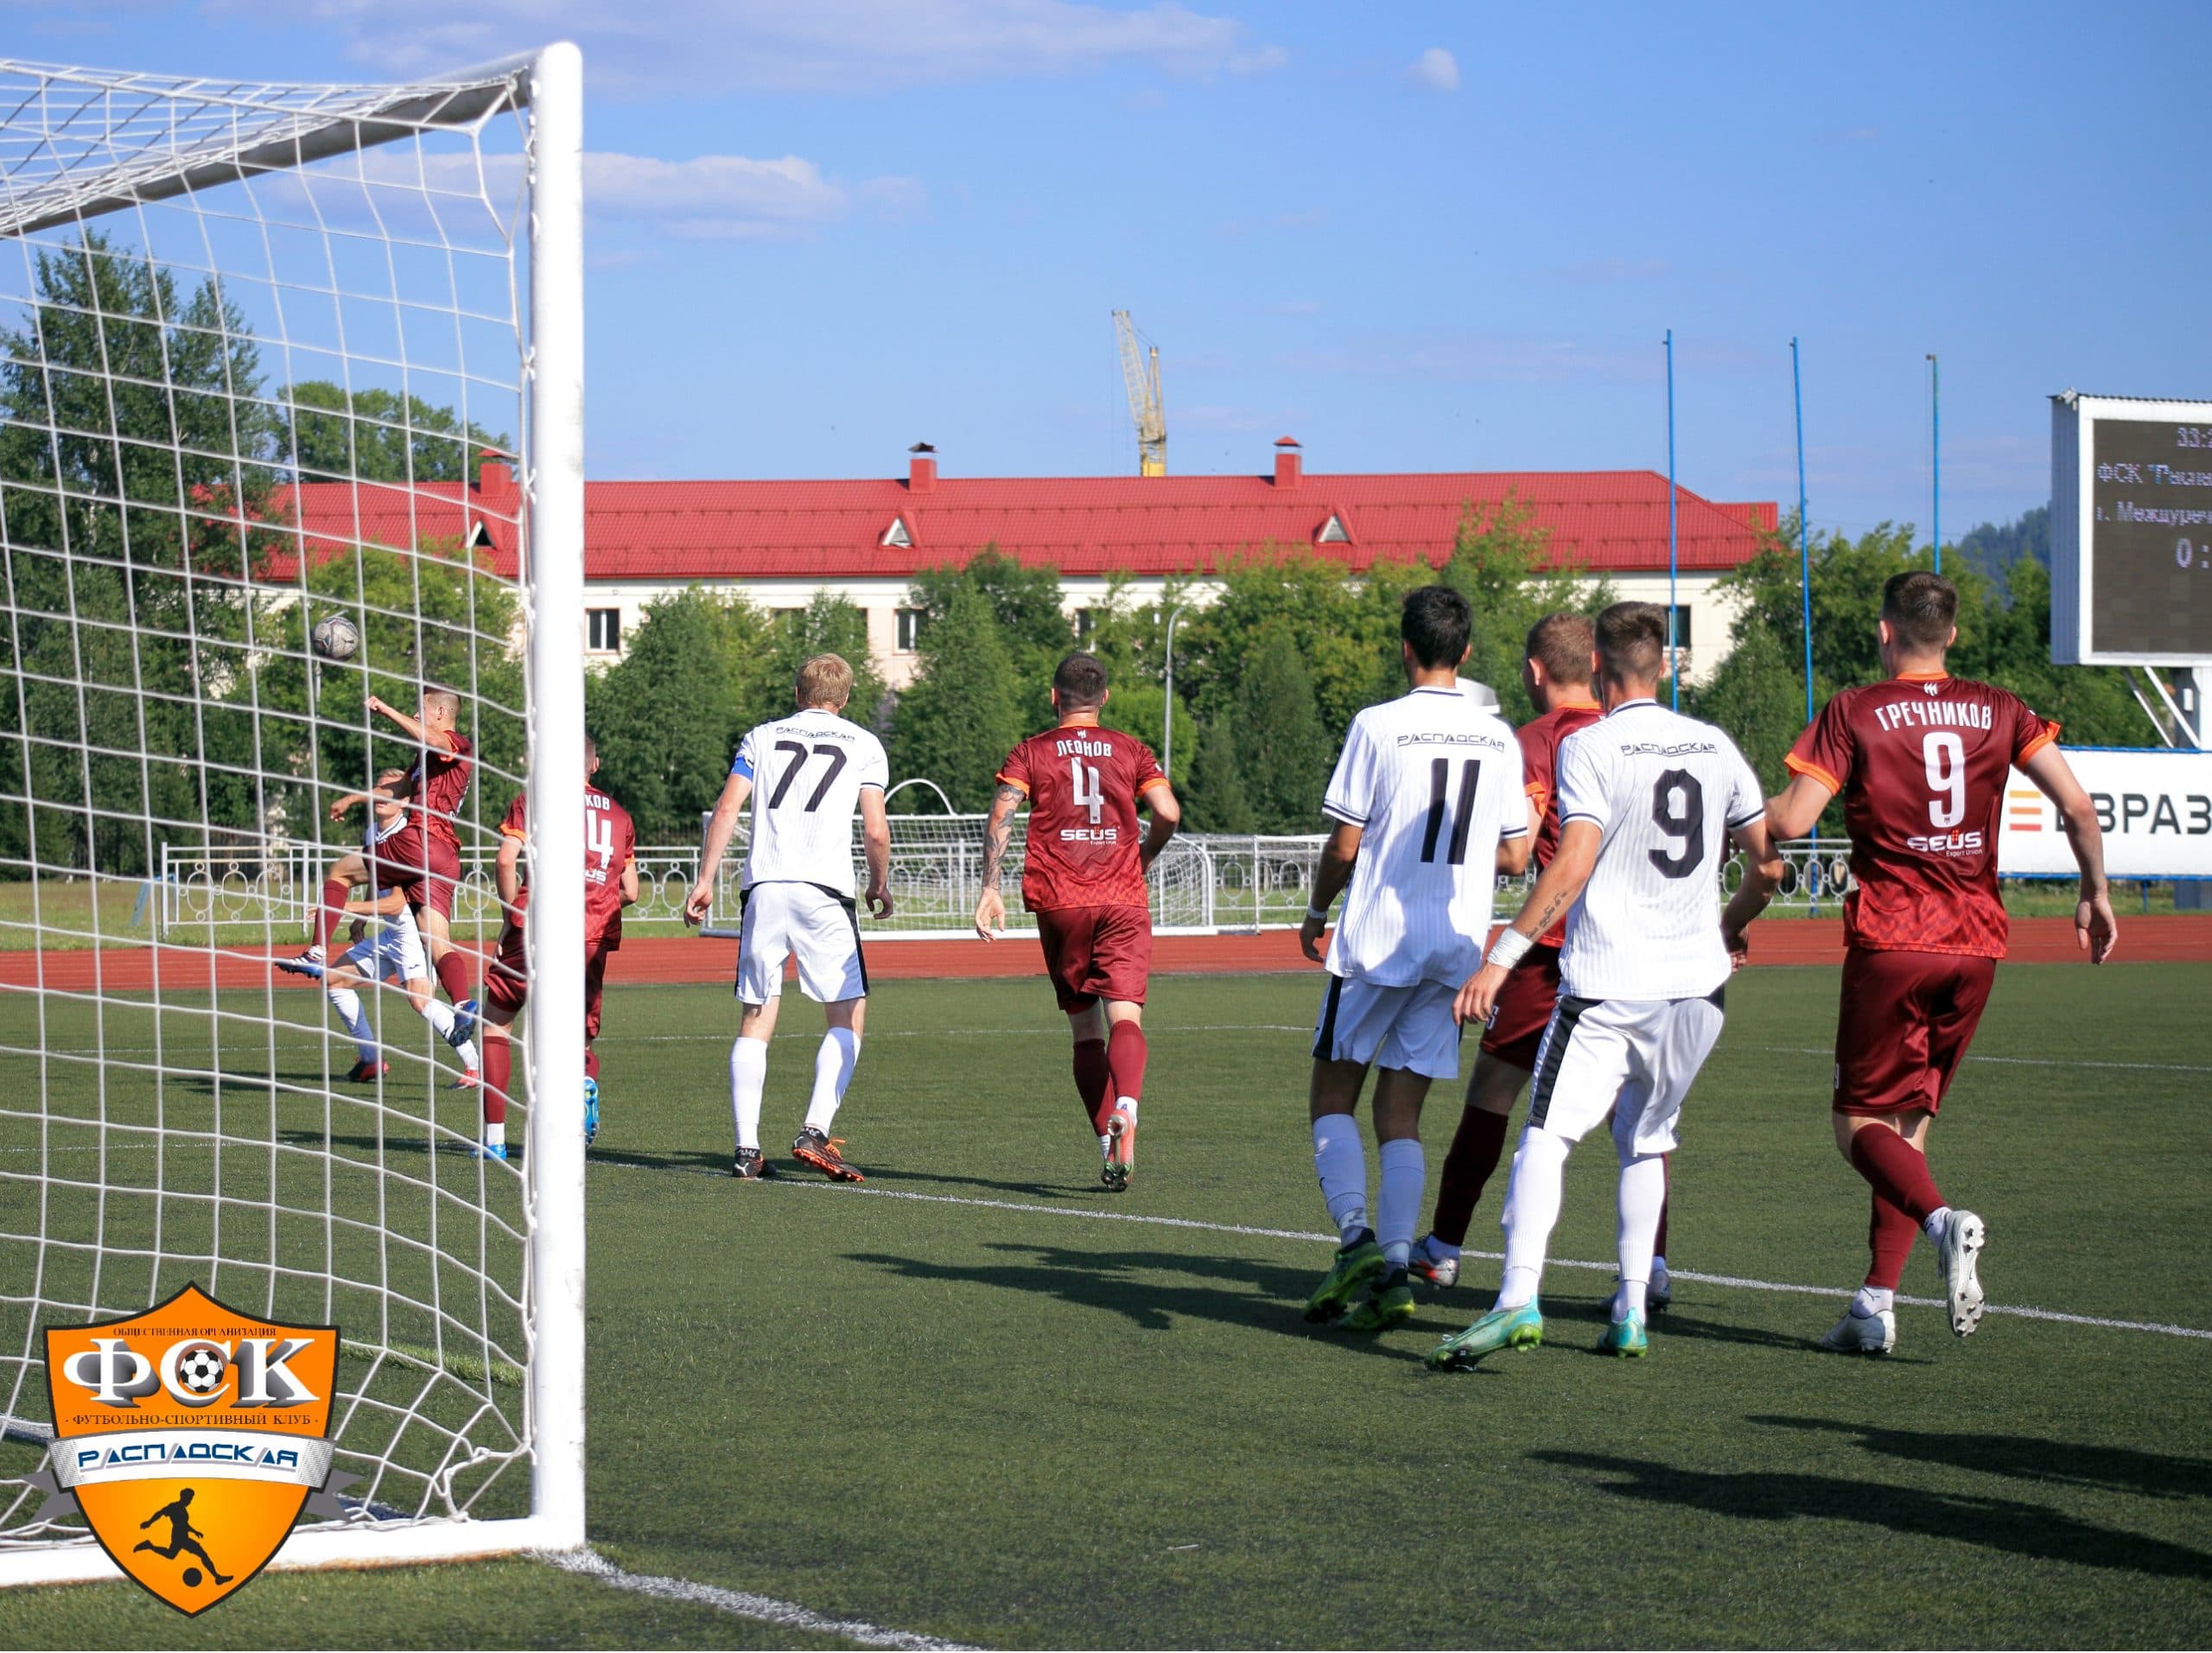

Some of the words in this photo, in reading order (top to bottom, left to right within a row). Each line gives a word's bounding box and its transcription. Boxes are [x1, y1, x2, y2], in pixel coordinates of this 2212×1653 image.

[1056, 741, 1112, 757] ЛЕОНОВ
[1396, 733, 1505, 753] РАСПАДСКАЯ
[1620, 742, 1718, 756] РАСПАДСКАЯ
[1874, 702, 1992, 731] ГРЕЧНИКОВ
[768, 741, 847, 812] 77
[1071, 757, 1104, 824] 4
[1923, 732, 1965, 828] 9
[1420, 758, 1481, 865] 11
[1648, 769, 1704, 879] 9
